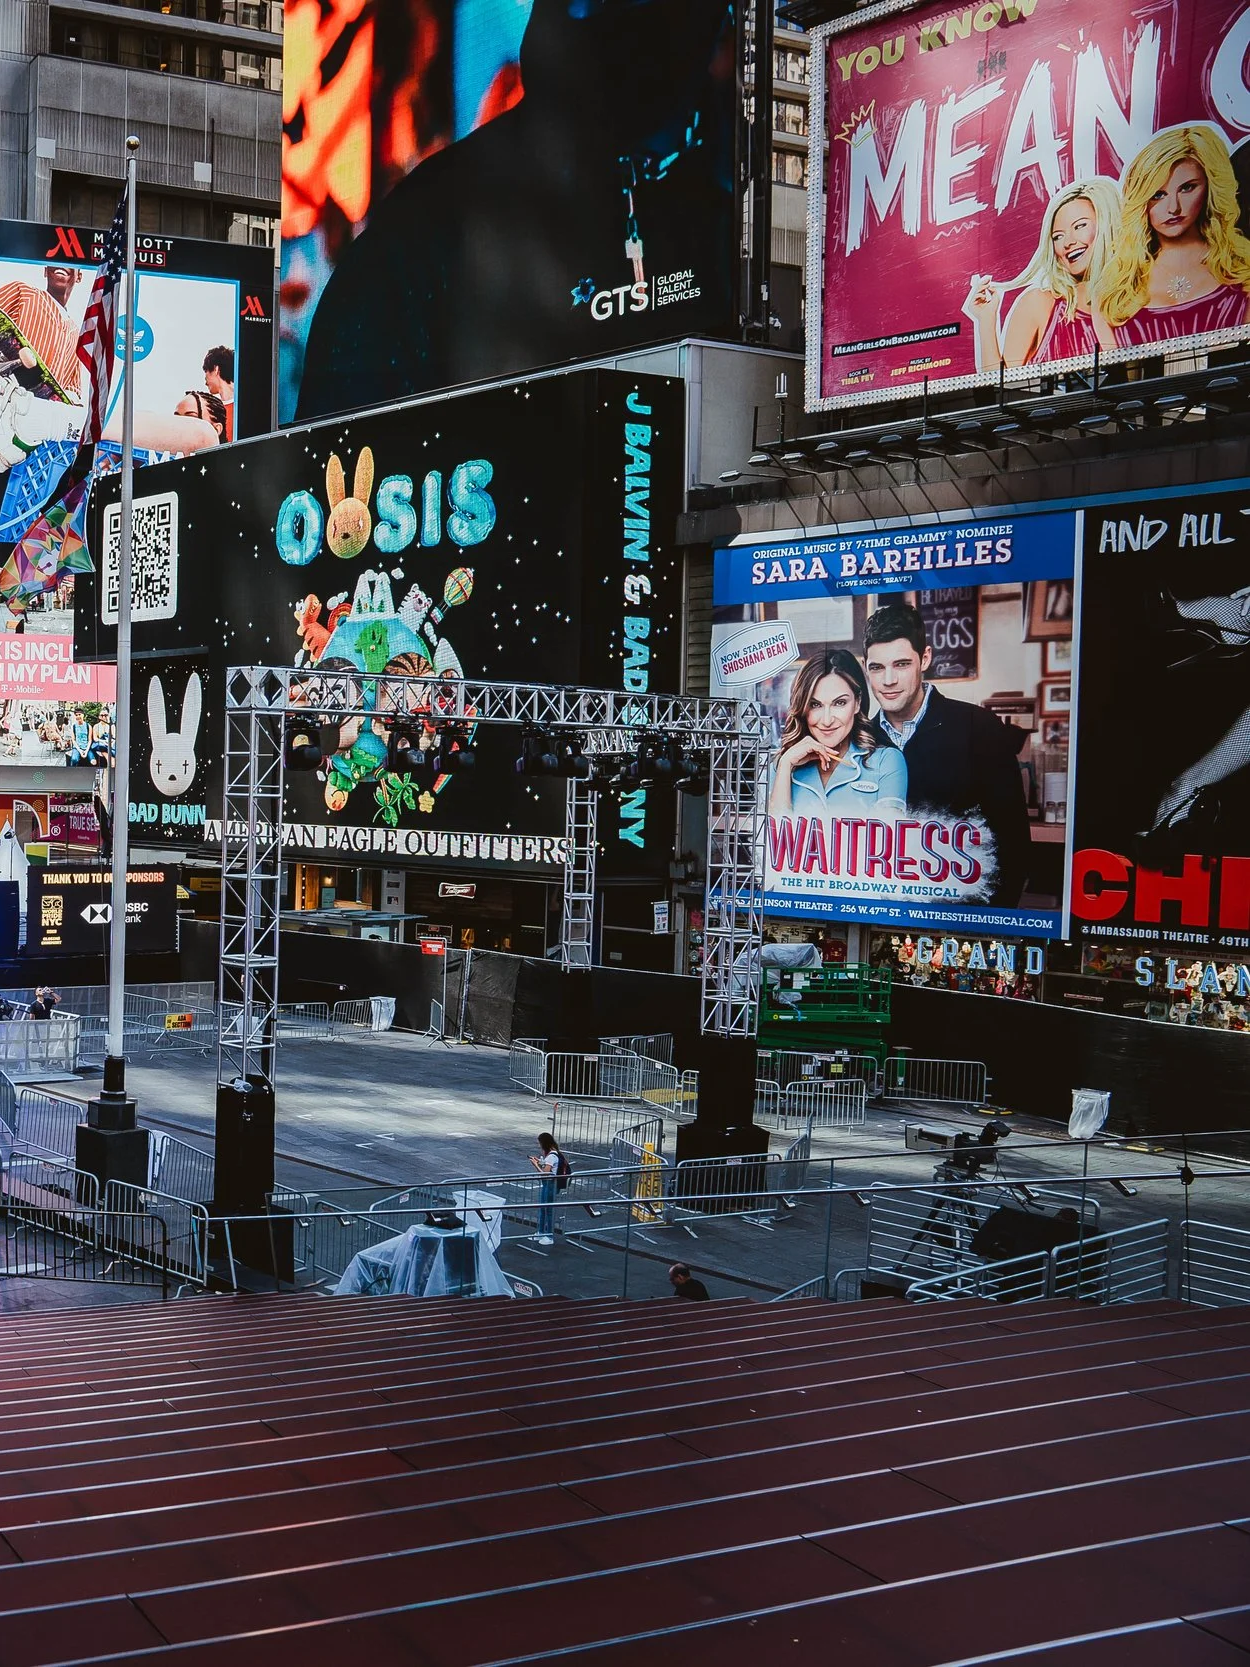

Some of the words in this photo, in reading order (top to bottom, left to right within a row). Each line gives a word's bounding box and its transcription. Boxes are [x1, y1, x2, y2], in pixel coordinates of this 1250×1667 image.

[837, 35, 905, 81] YOU
[918, 0, 1037, 54] KNOW
[844, 21, 1161, 257] MEAN
[94, 233, 173, 251] MIOTT
[94, 248, 164, 264] MUIS
[657, 269, 694, 286] GLOBAL
[657, 279, 692, 296] TALENT
[591, 281, 649, 321] GTS
[657, 288, 701, 306] SERVICES
[841, 377, 860, 386] TINA
[861, 373, 875, 382] FEY
[890, 366, 907, 377] JEFF
[908, 358, 951, 373] RICHMOND
[626, 392, 651, 415] J
[623, 422, 651, 562] BALVIN
[753, 546, 801, 560] ORIGINAL
[803, 543, 837, 555] MUSIC
[839, 541, 853, 551] BY
[856, 537, 891, 550] 7-TIME
[956, 525, 1013, 540] NOMINEE
[1099, 515, 1168, 553] AND
[1179, 513, 1236, 548] ALL
[752, 557, 829, 585] SARA
[840, 538, 1012, 577] BAREILLES
[624, 573, 652, 605] &
[5, 641, 22, 660] IS
[622, 615, 650, 693] BAD
[720, 648, 740, 664] NOW
[741, 633, 786, 657] STARRING
[722, 651, 766, 676] SHOSHANA
[767, 641, 789, 660] BEAN
[7, 663, 40, 683] MY
[41, 665, 91, 685] PLAN
[618, 705, 647, 848] BNY
[128, 802, 159, 823] BAD
[161, 803, 206, 826] BUNN
[206, 821, 318, 848] AMERICAN
[324, 828, 398, 854] EAGLE
[404, 830, 573, 864] OUTFITTERS
[766, 815, 981, 885] WAITRESS
[42, 873, 72, 885] THANK
[73, 873, 90, 884] YOU
[91, 873, 103, 884] TO
[781, 877, 802, 887] THE
[806, 879, 825, 889] HIT
[829, 880, 897, 895] BROADWAY
[902, 885, 960, 899] MUSICAL
[1072, 848, 1250, 931] CHI
[124, 903, 149, 912] SBC
[124, 914, 141, 923] ank
[794, 901, 833, 912] THEATRE
[840, 904, 856, 913] 256
[888, 908, 901, 917] ST.
[909, 909, 1053, 929] WAITRESSTHEMUSICAL.COM
[42, 919, 63, 927] NYC
[1091, 926, 1159, 940] AMBASSADOR
[1162, 931, 1209, 944] THEATRE
[1219, 936, 1249, 948] 49TH
[917, 937, 1045, 975] GRAND
